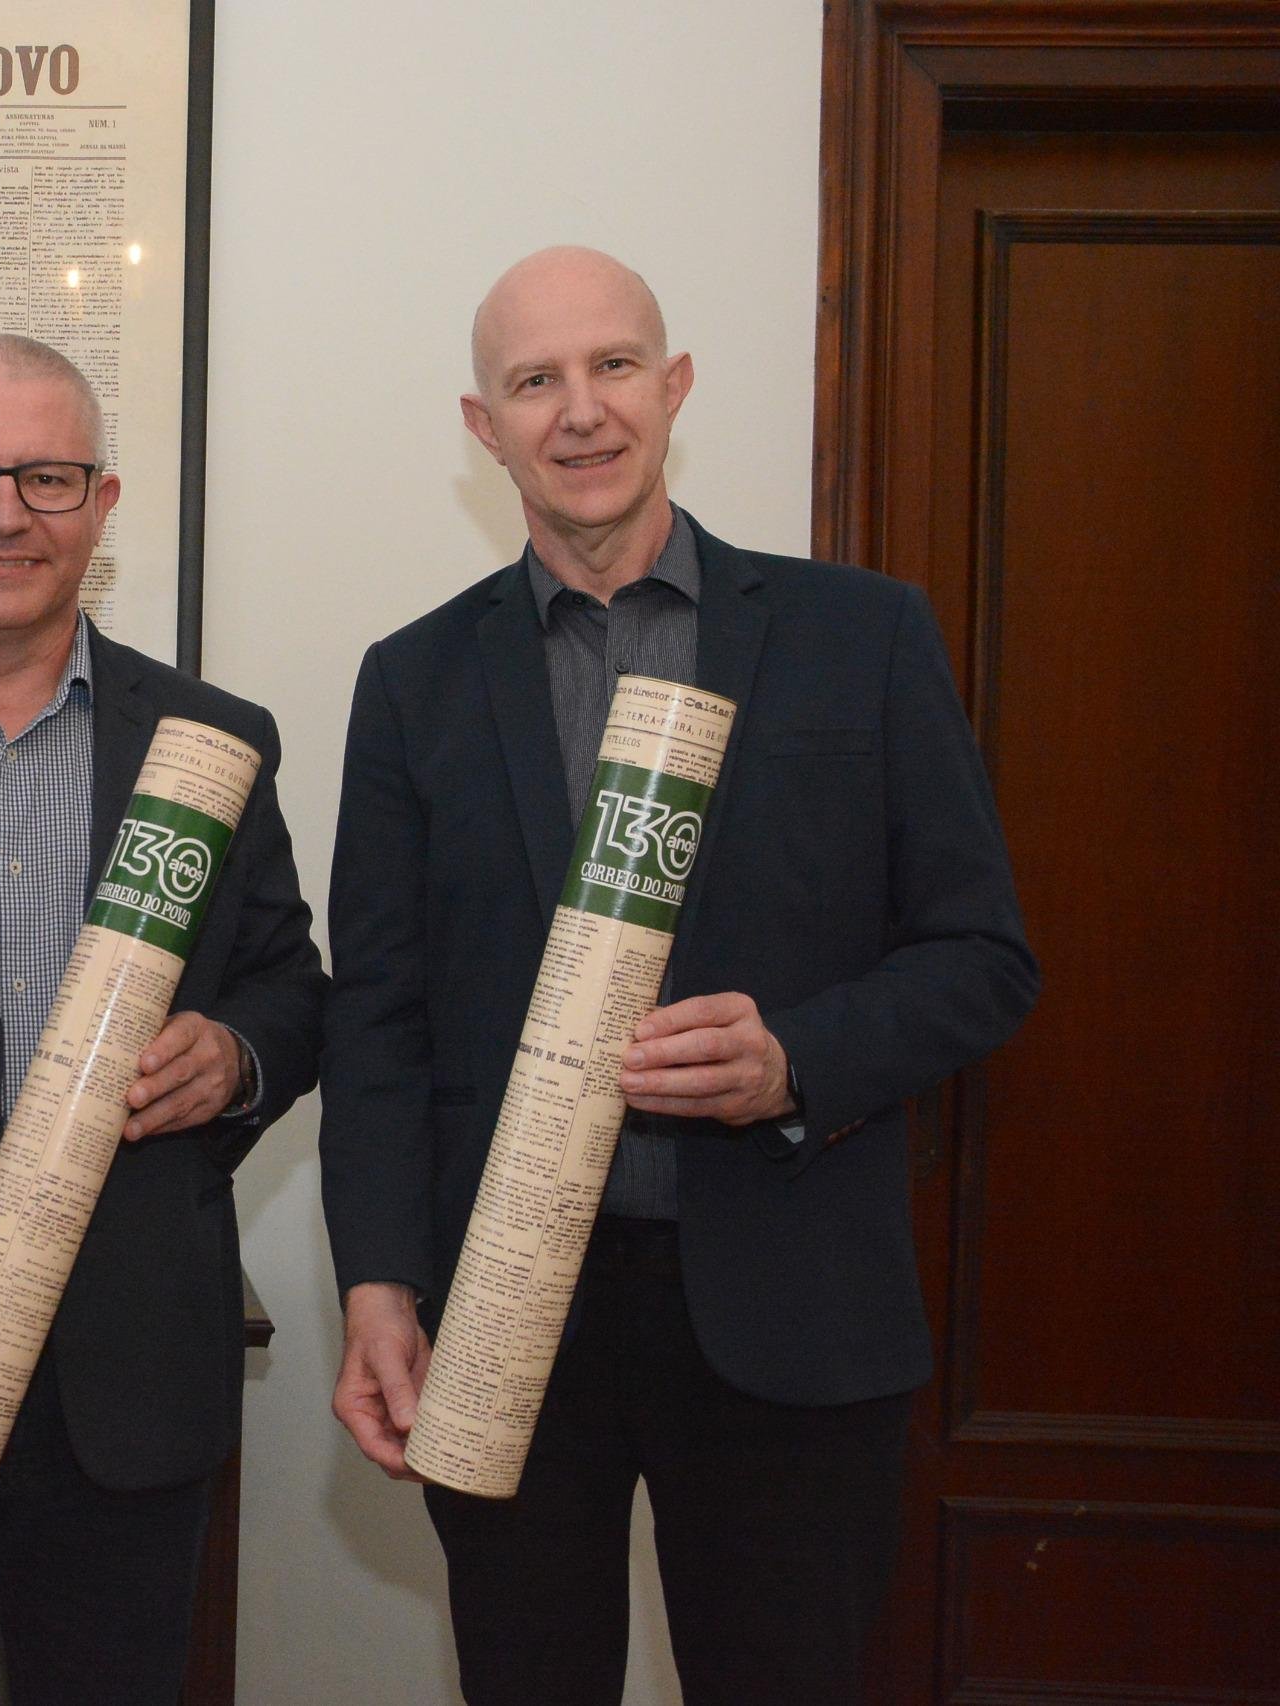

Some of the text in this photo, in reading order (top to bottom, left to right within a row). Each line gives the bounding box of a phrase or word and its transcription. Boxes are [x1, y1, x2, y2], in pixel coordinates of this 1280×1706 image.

[88, 119, 110, 129] NUM.
[633, 685, 670, 702] director
[683, 696, 729, 719] Caldas
[195, 733, 244, 760] Caldas
[705, 731, 716, 741] DE
[215, 766, 225, 778] DE
[591, 789, 702, 881] 130
[666, 834, 697, 855] anos
[105, 819, 212, 904] 130
[168, 858, 205, 882] anos
[581, 860, 686, 902] CORREIO DO POVO
[97, 881, 191, 926] CORREIO DO POVO
